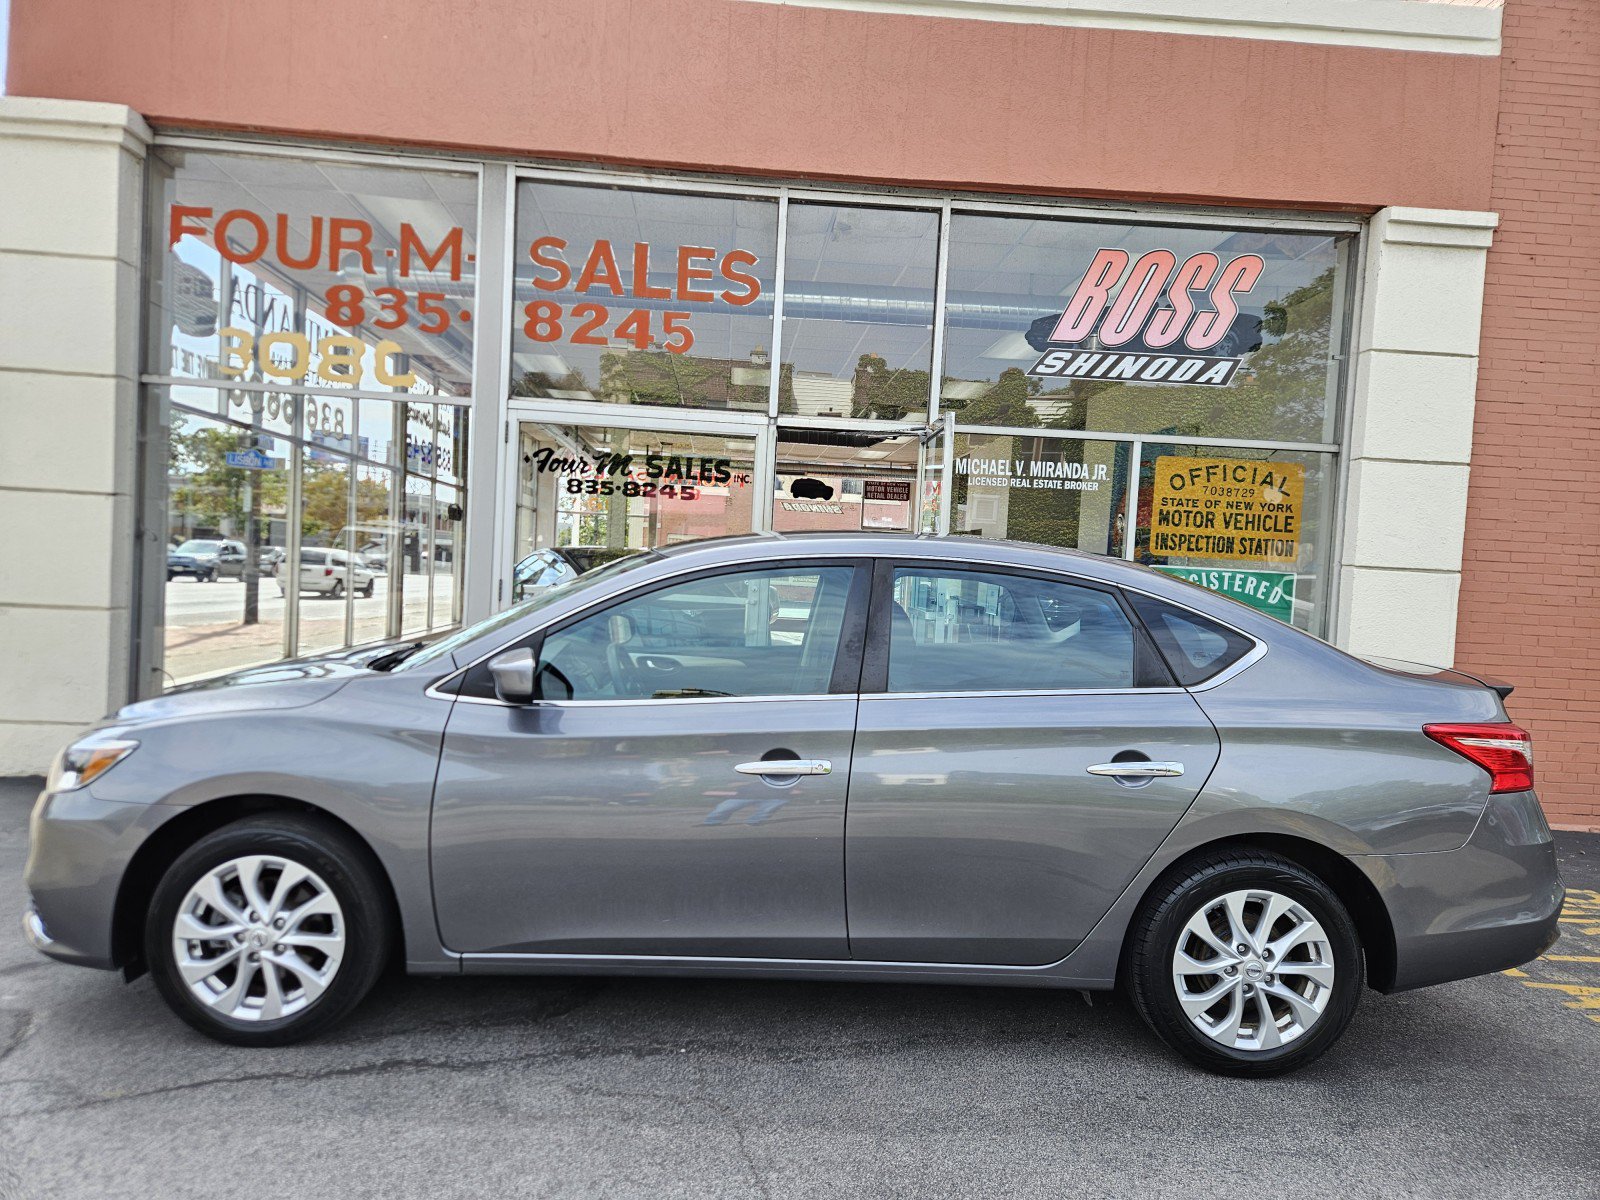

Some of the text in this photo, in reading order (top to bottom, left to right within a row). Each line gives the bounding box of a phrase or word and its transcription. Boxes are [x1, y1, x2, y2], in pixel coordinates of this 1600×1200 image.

[529, 236, 761, 306] SALES
[1047, 247, 1265, 350] BOSS
[524, 300, 695, 354] 8245
[1035, 351, 1234, 385] SHINODA
[645, 454, 731, 483] SALES
[955, 458, 1110, 481] MICHAEL V. MIRANDA JR.
[1169, 464, 1291, 497] OFFICIAL
[866, 485, 909, 494] MOTOR VEHICLE
[968, 476, 1099, 491] LICENSED REAL ESTATE BROKER
[1202, 486, 1255, 498] 7038729
[1161, 497, 1293, 513] STATE OF NEW YORK
[1158, 509, 1295, 533] MOTOR VEHICLE
[1155, 532, 1294, 557] INSPECTION STATION
